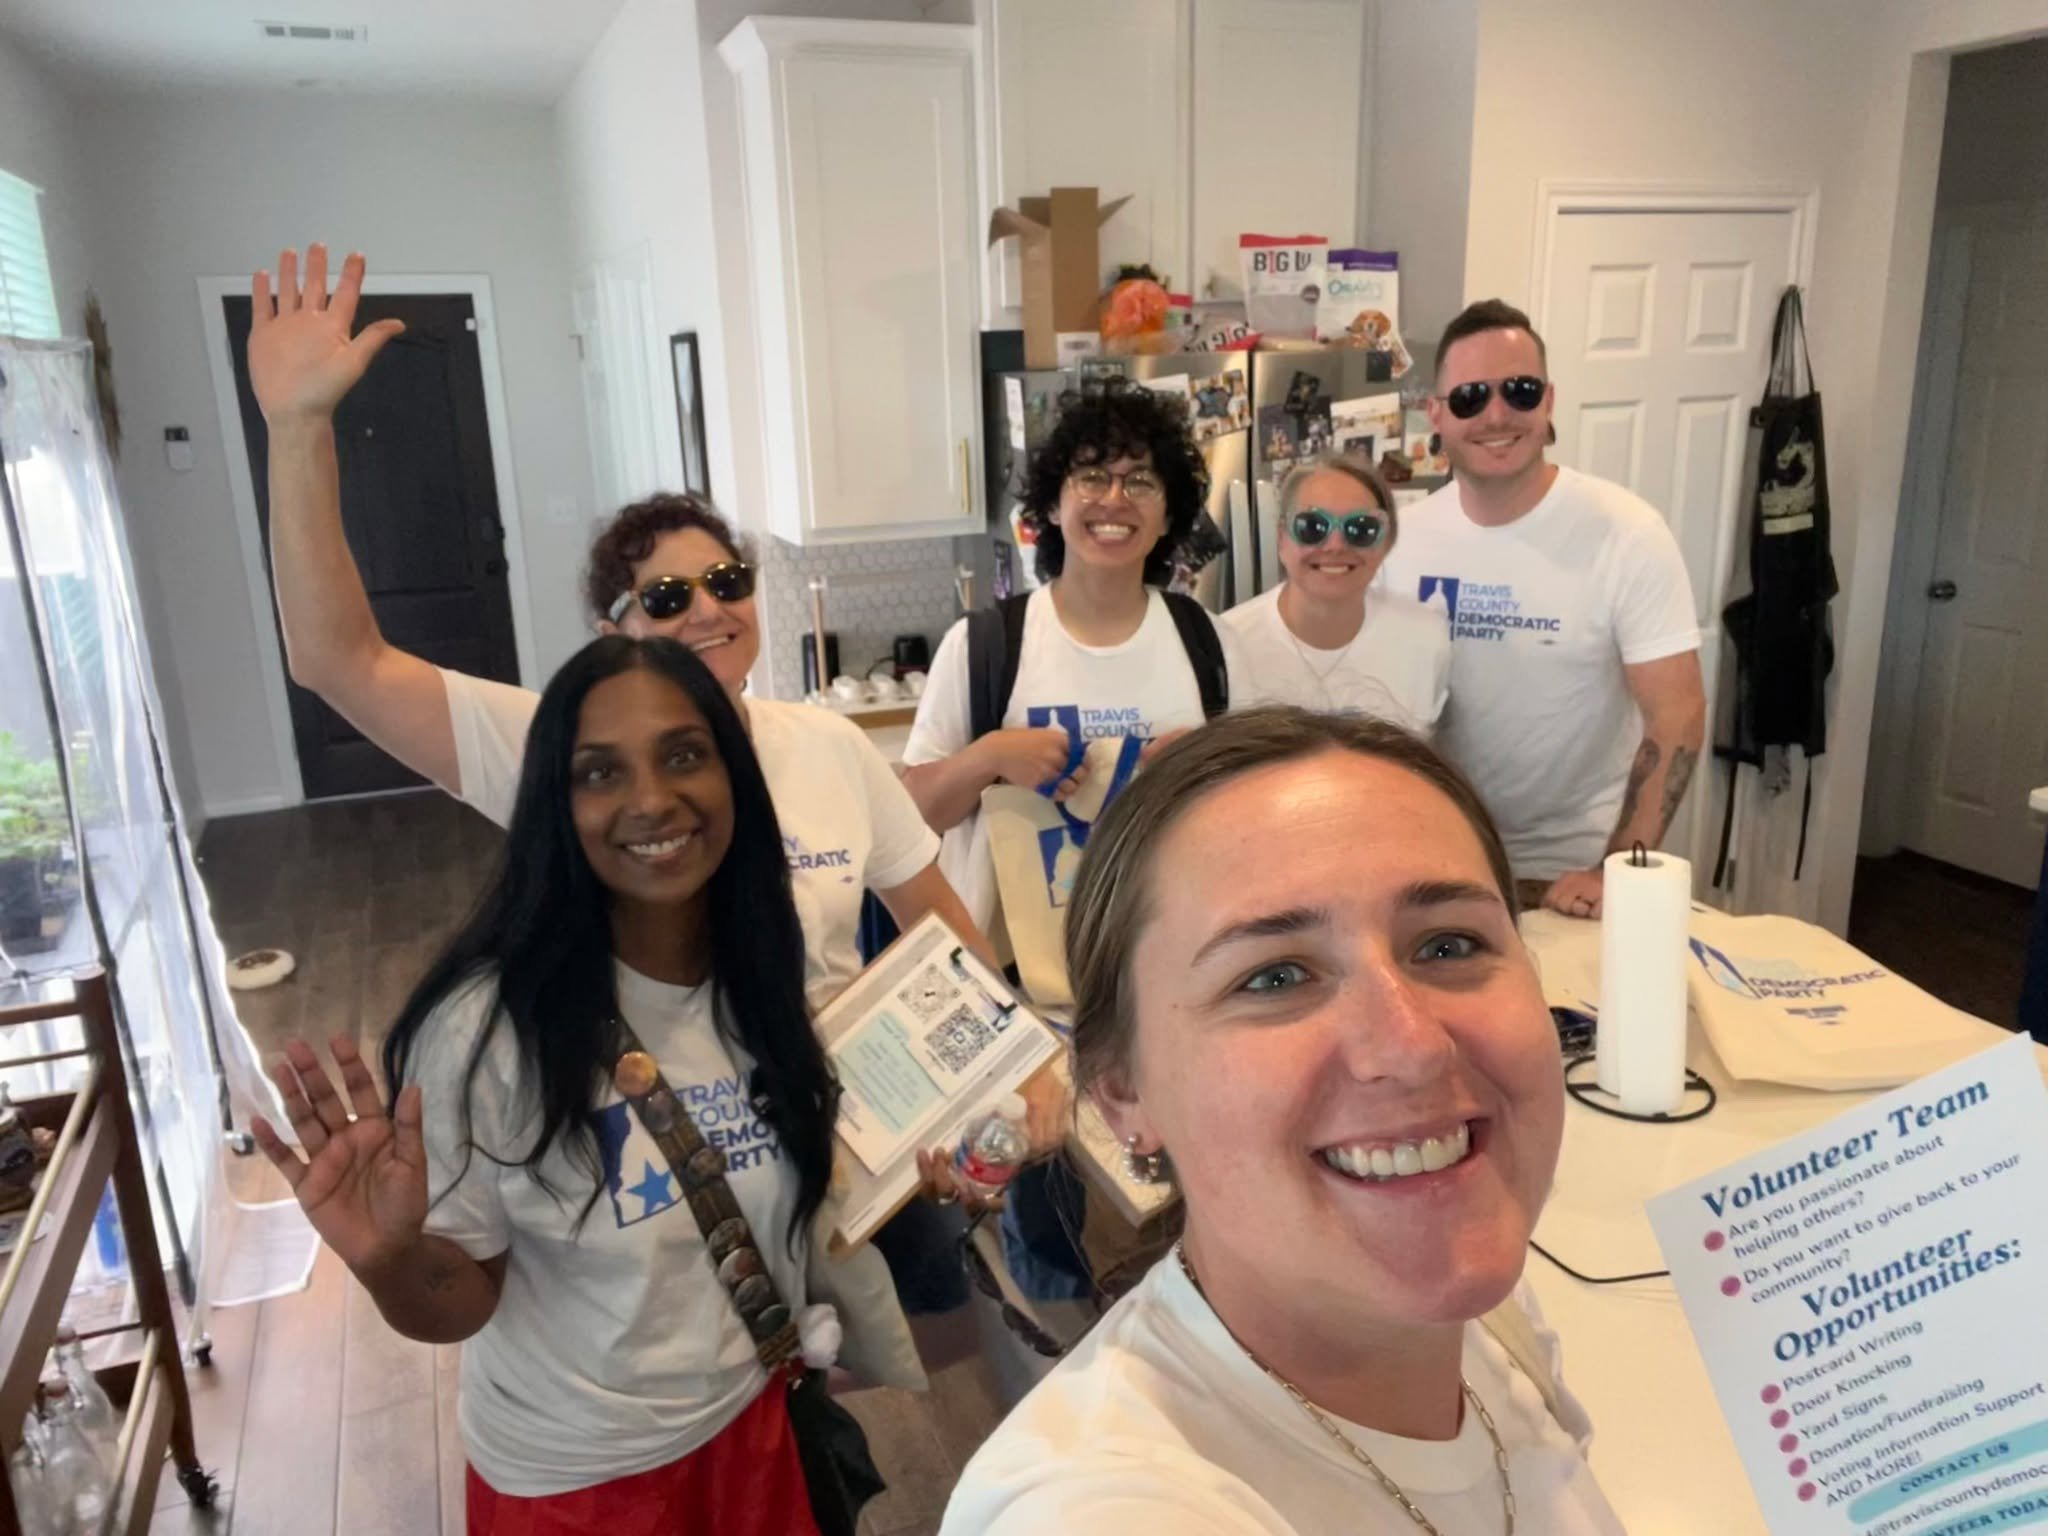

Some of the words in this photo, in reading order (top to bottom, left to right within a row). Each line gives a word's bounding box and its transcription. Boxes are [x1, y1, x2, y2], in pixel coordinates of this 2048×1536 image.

[1254, 251, 1289, 273] BIG
[1459, 598, 1520, 613] COUNTY
[1462, 583, 1513, 598] TRAVIS
[1456, 626, 1505, 641] PARTY
[1457, 611, 1560, 632] DEMOCRATIC
[1081, 707, 1140, 723] TRAVIS
[1082, 722, 1152, 739] COUNTY
[787, 849, 851, 869] CRATIC
[1749, 969, 1887, 989] DEMOCRATIC
[1759, 987, 1826, 999] PARTY
[1700, 1129, 1879, 1218] Volunteer
[1887, 1081, 1990, 1138] Team
[1728, 1217, 1760, 1240] Are
[1763, 1202, 1796, 1226] you
[1799, 1160, 1890, 1211] passionate
[1894, 1135, 1945, 1166] about
[1734, 1223, 1799, 1259] helping
[1803, 1190, 1865, 1229] others?
[1743, 1267, 1770, 1284] Do
[1773, 1251, 1805, 1275] you
[1808, 1228, 1852, 1255] want
[1854, 1219, 1874, 1234] to
[1877, 1201, 1913, 1227] give
[1916, 1182, 1957, 1207] back
[1959, 1173, 1979, 1187] to
[1982, 1153, 2021, 1180] your
[1751, 1248, 1851, 1304] community?
[1801, 1229, 1972, 1317] Volunteer
[1774, 1239, 2021, 1361] Opportunities:
[1783, 1348, 1857, 1391] Postcard
[1858, 1321, 1924, 1356] Writing
[1791, 1389, 1832, 1417] Door
[1835, 1354, 1912, 1395] Knocking
[1799, 1413, 1840, 1439] Yard
[1841, 1393, 1888, 1420] Signs
[1809, 1379, 1985, 1465] Donation/Fundraising
[1817, 1455, 1872, 1487] Voting
[1874, 1412, 1971, 1460] Information
[1974, 1383, 2045, 1417] Support
[1826, 1479, 1864, 1507] AND
[1865, 1450, 1923, 1485] MORE!
[1899, 1453, 1981, 1493] CONTACT
[1985, 1441, 2010, 1458] US
[1927, 1514, 1993, 1536] NTEER
[1996, 1498, 2048, 1521] TODA
